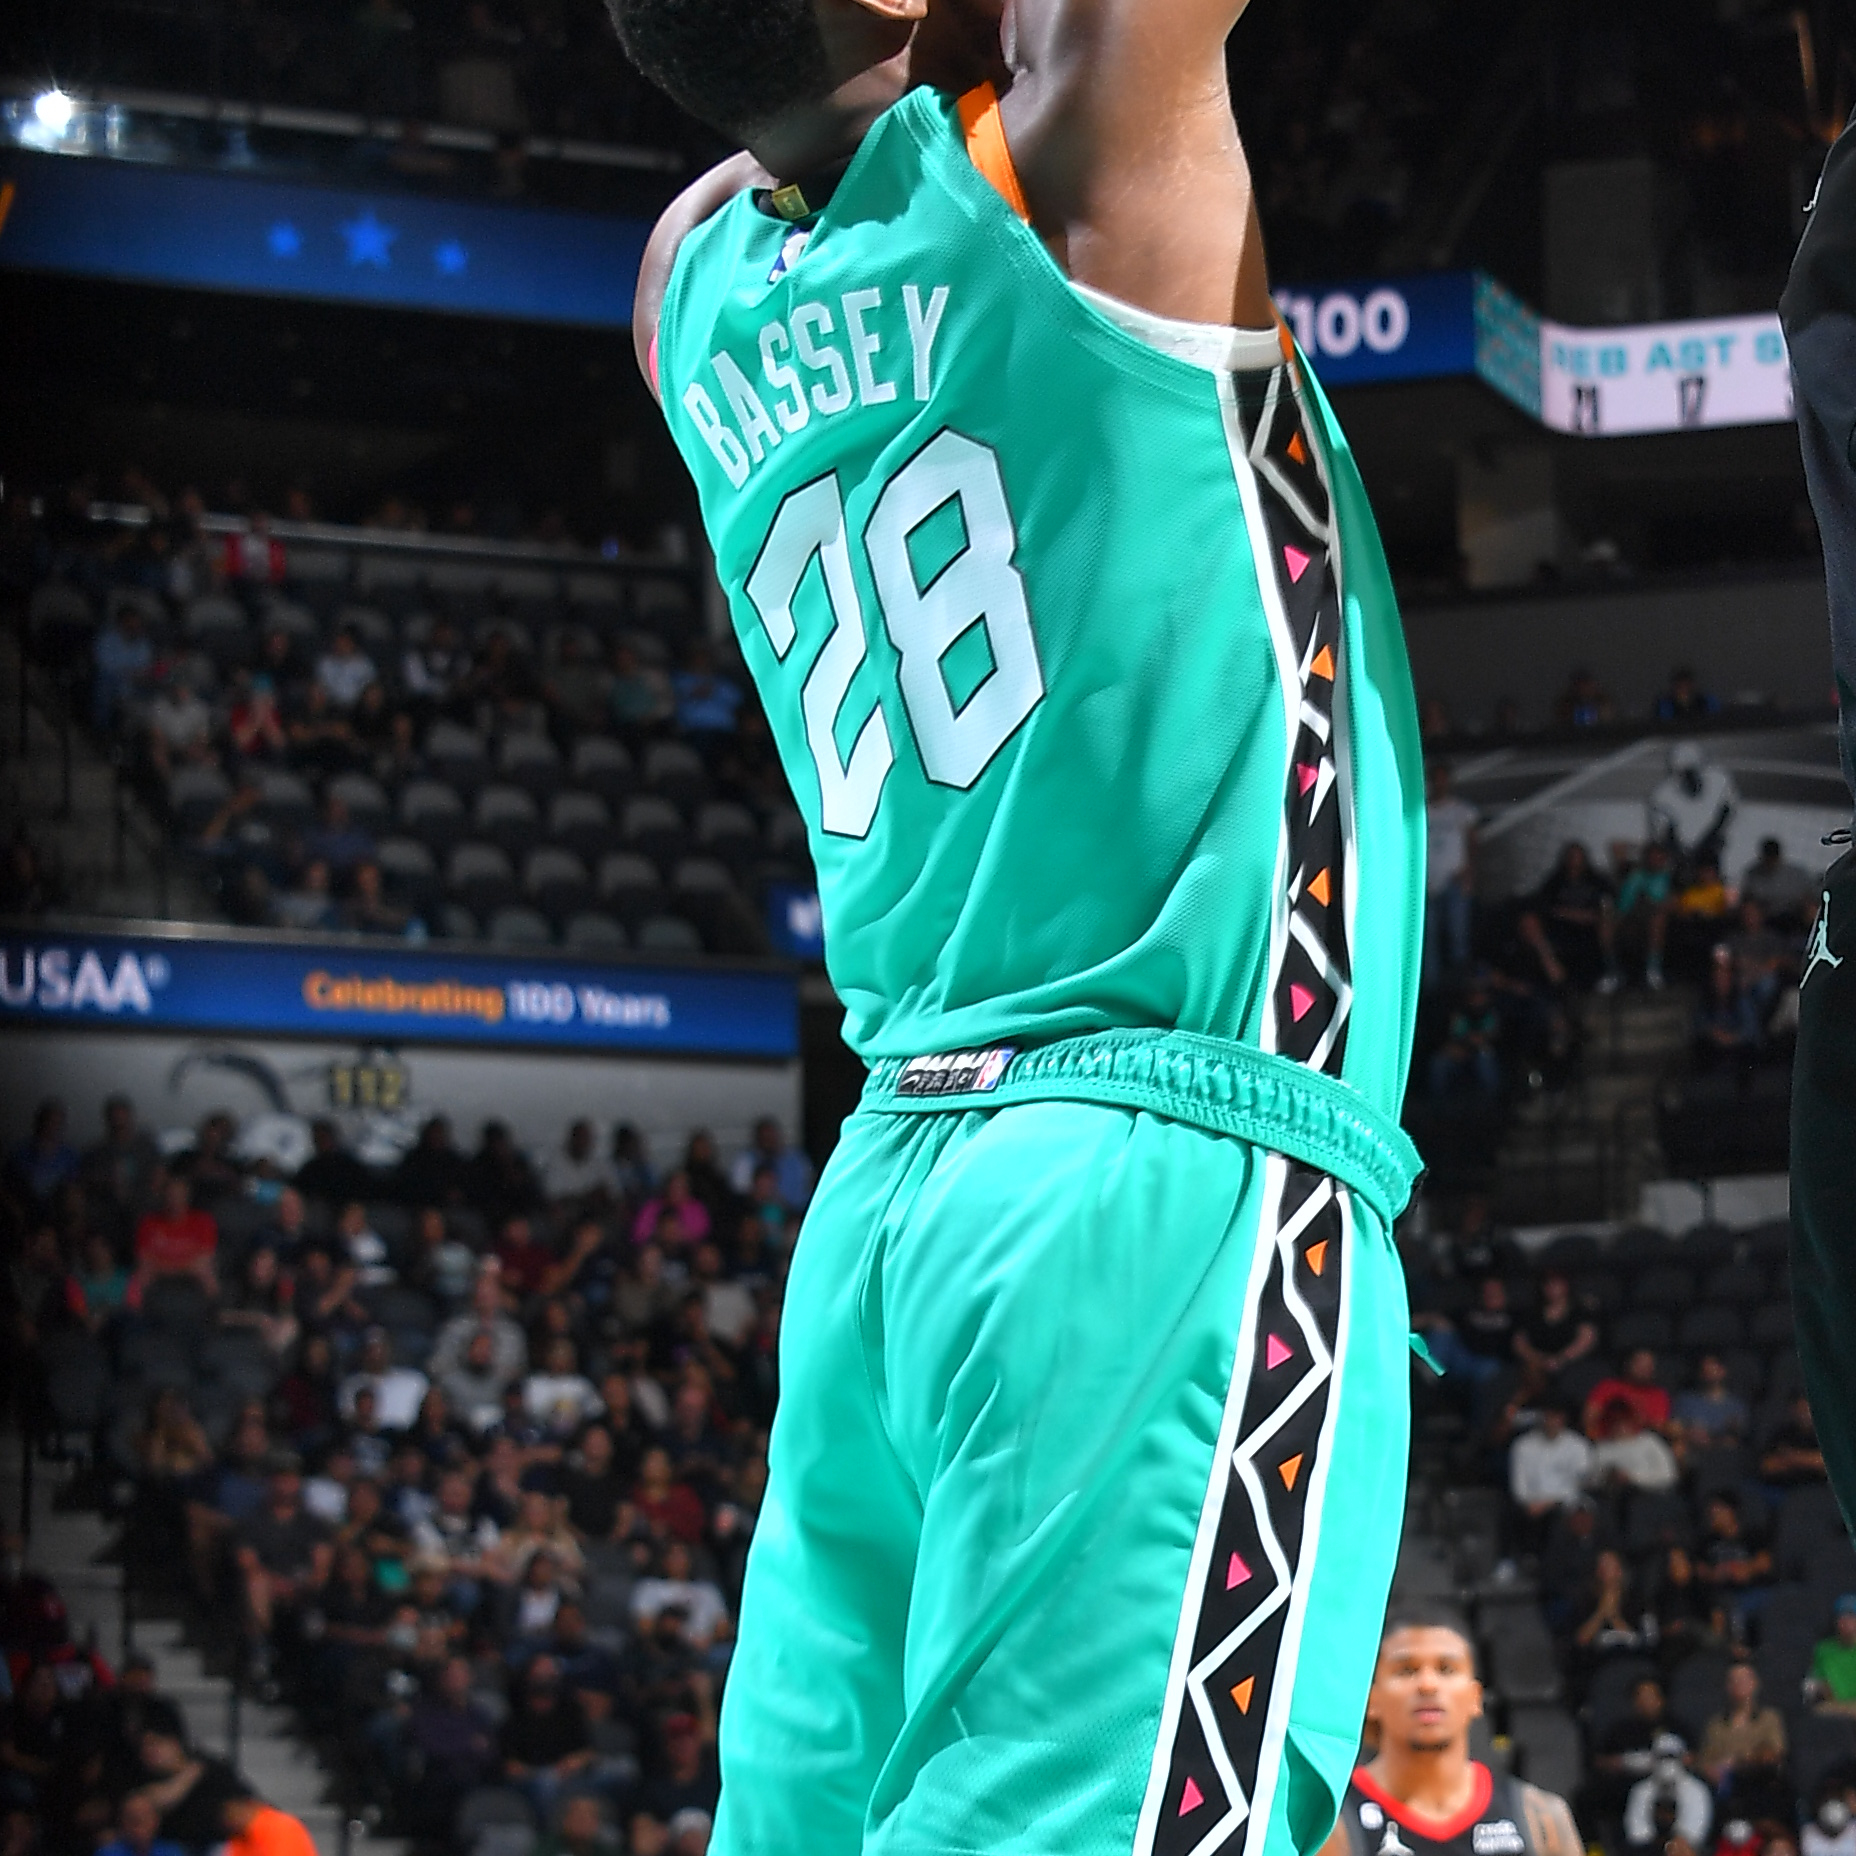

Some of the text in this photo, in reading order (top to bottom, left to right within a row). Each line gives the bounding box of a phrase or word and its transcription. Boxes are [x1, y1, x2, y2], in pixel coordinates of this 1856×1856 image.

[683, 285, 950, 490] BASSEY
[744, 425, 1047, 840] 28
[0, 947, 151, 1015] USAA
[303, 970, 672, 1030] Celebrating 100 Years
